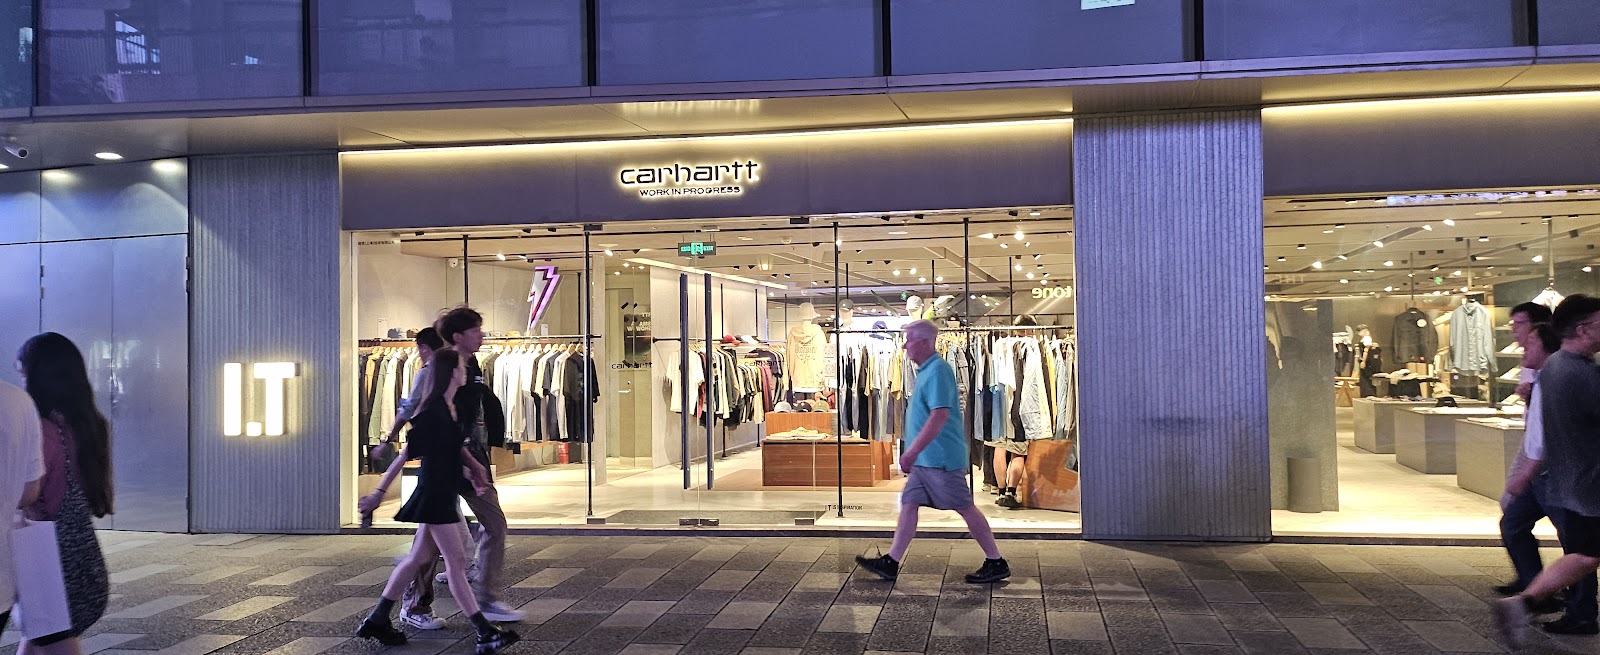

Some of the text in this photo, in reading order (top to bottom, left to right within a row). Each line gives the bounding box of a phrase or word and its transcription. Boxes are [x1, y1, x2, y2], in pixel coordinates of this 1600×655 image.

[620, 161, 758, 185] carhartt
[640, 186, 741, 197] WORK IN PROGRESS
[224, 362, 296, 437] I.T
